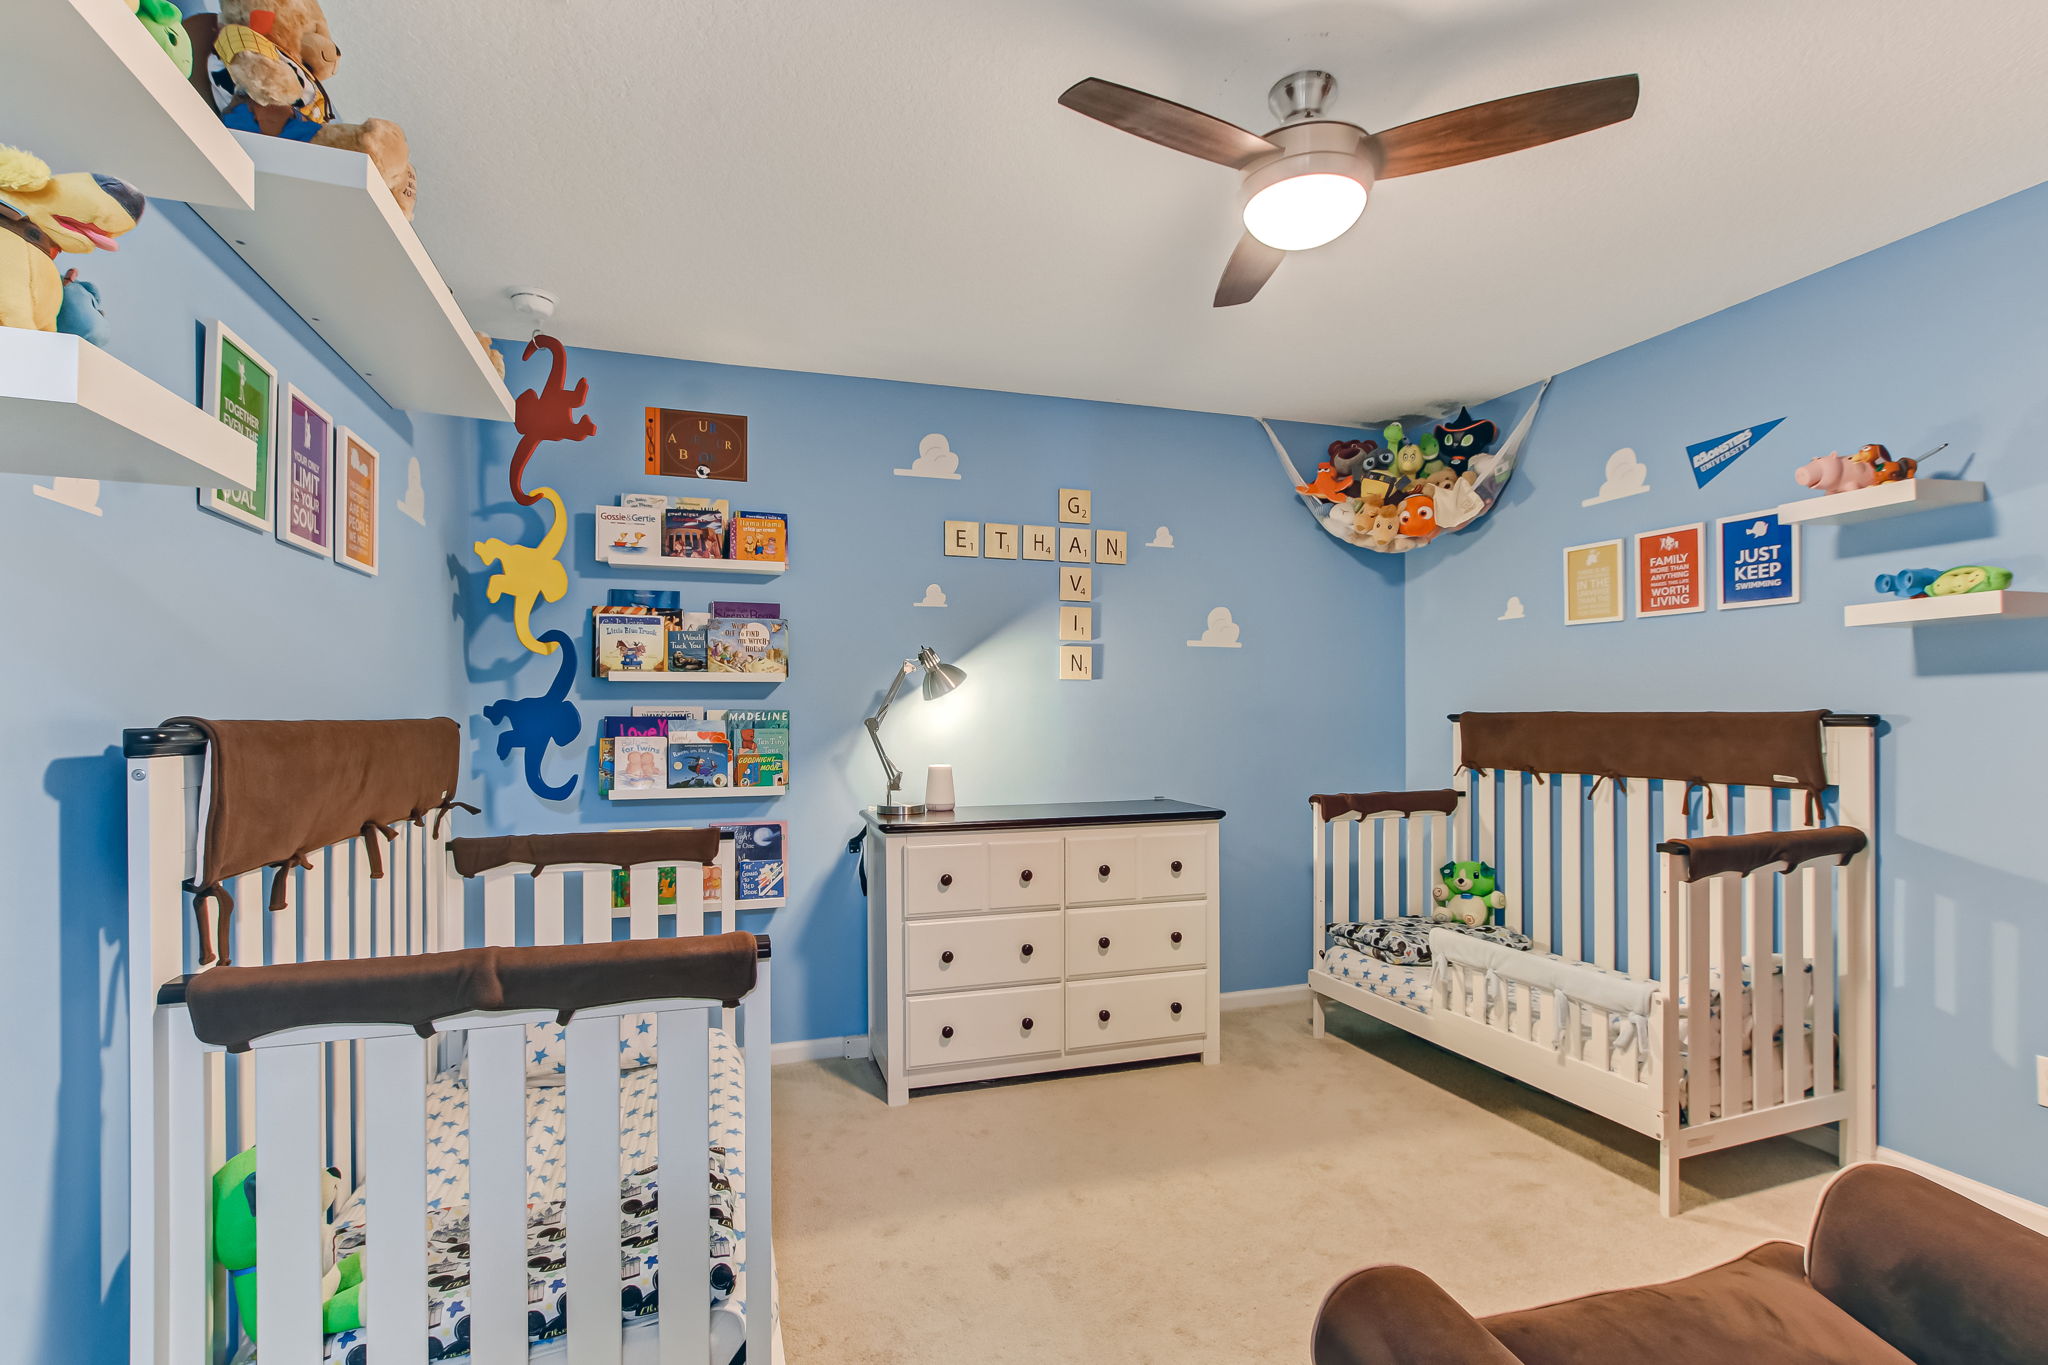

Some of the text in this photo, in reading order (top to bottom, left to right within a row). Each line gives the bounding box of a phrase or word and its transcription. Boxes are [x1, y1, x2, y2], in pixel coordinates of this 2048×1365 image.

[224, 396, 259, 431] TOGETHER
[294, 450, 320, 474] YOUR ONLY
[1700, 440, 1750, 472] UNIVERSITY
[294, 462, 320, 496] LIMIT
[294, 486, 320, 514] IS YOUR
[293, 504, 320, 535] SOUL
[600, 512, 626, 520] Gossie
[632, 514, 656, 522] Gertie
[1650, 552, 1688, 568] FAMILY
[1734, 544, 1782, 564] JUST
[1670, 564, 1690, 572] THAN
[1734, 562, 1782, 582] KEEP
[1651, 570, 1690, 580] ANYTHING
[1651, 584, 1690, 596] WORTH
[1735, 578, 1782, 590] SWIMMING
[1650, 594, 1690, 608] LIVING
[606, 627, 622, 635] Little
[638, 626, 656, 636] Truck
[728, 711, 788, 721] MADELINE
[770, 737, 785, 746] Tiny
[636, 744, 660, 754] Twins
[738, 756, 776, 764] GOODNIGHT
